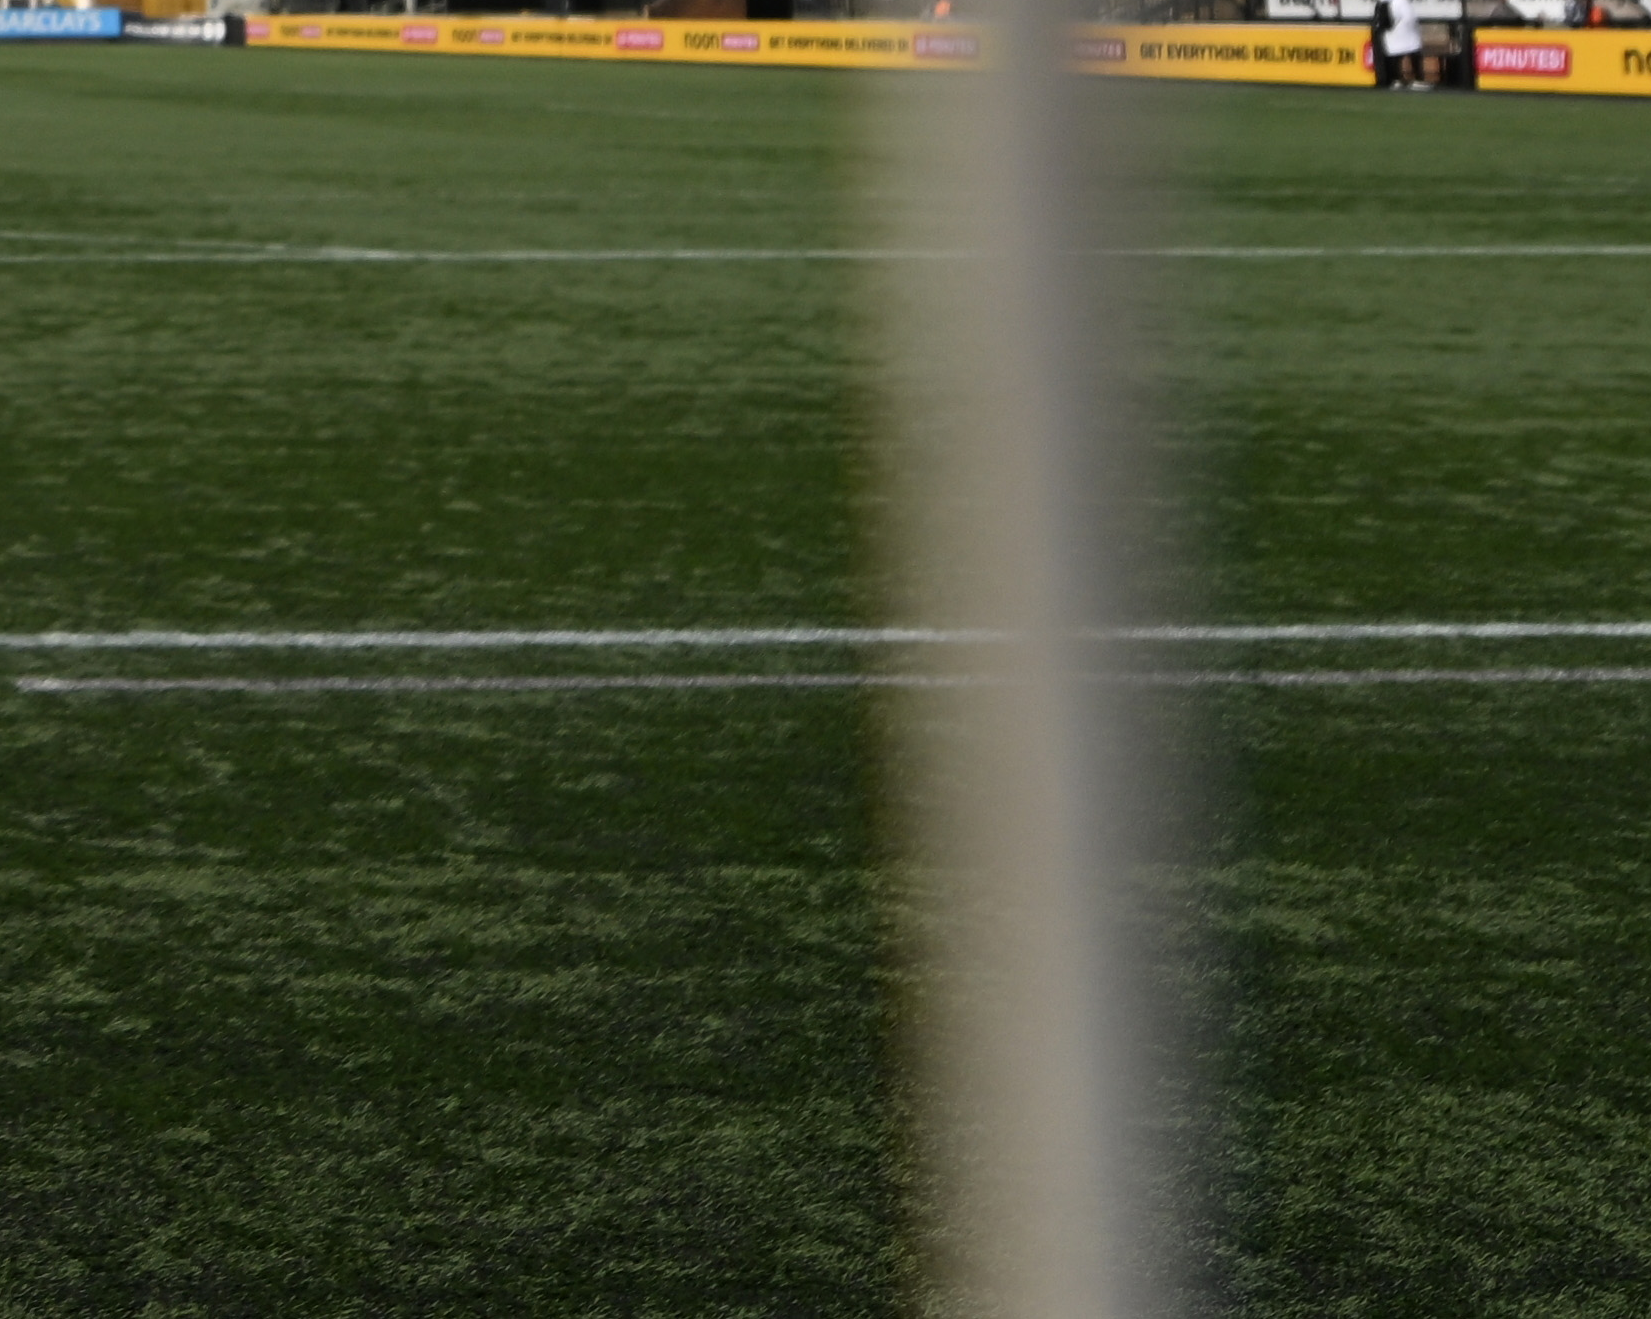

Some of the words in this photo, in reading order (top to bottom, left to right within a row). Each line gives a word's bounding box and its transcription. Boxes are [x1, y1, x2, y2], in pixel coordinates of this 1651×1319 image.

[1140, 42, 1163, 59] GET
[1166, 43, 1248, 62] EVERYTHING
[1253, 45, 1332, 63] DELIVERED
[1338, 48, 1355, 65] IN
[1482, 47, 1565, 71] MINUTES!
